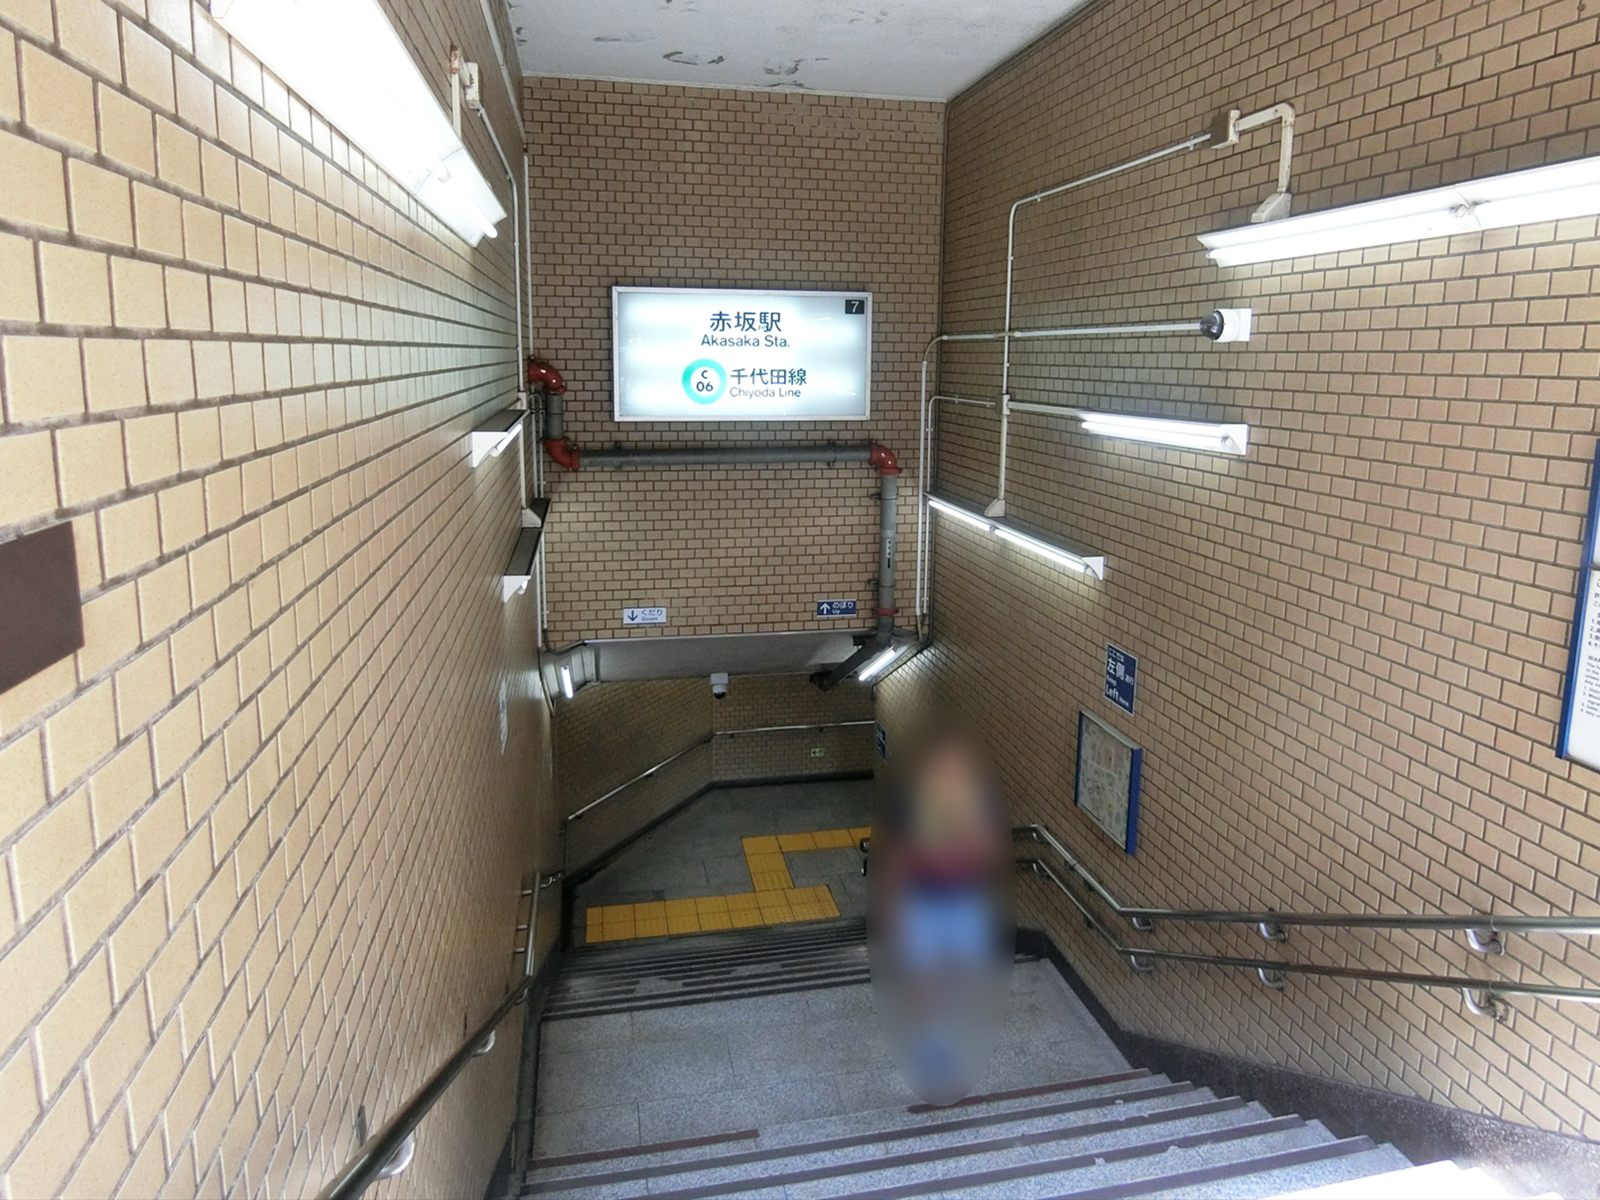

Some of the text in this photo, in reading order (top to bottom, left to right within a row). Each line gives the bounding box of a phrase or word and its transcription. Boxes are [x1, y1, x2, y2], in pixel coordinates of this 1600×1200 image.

[850, 300, 860, 314] 7
[709, 311, 782, 333] 赤坂駅
[700, 334, 790, 348] Akasaka Sta.
[701, 370, 709, 380] C
[730, 368, 808, 386] 千代田線
[696, 381, 714, 393] 06
[729, 386, 802, 400] Chiyoda Line
[832, 601, 854, 609] のぼり
[641, 608, 663, 617] くだり
[1106, 684, 1119, 700] Left
